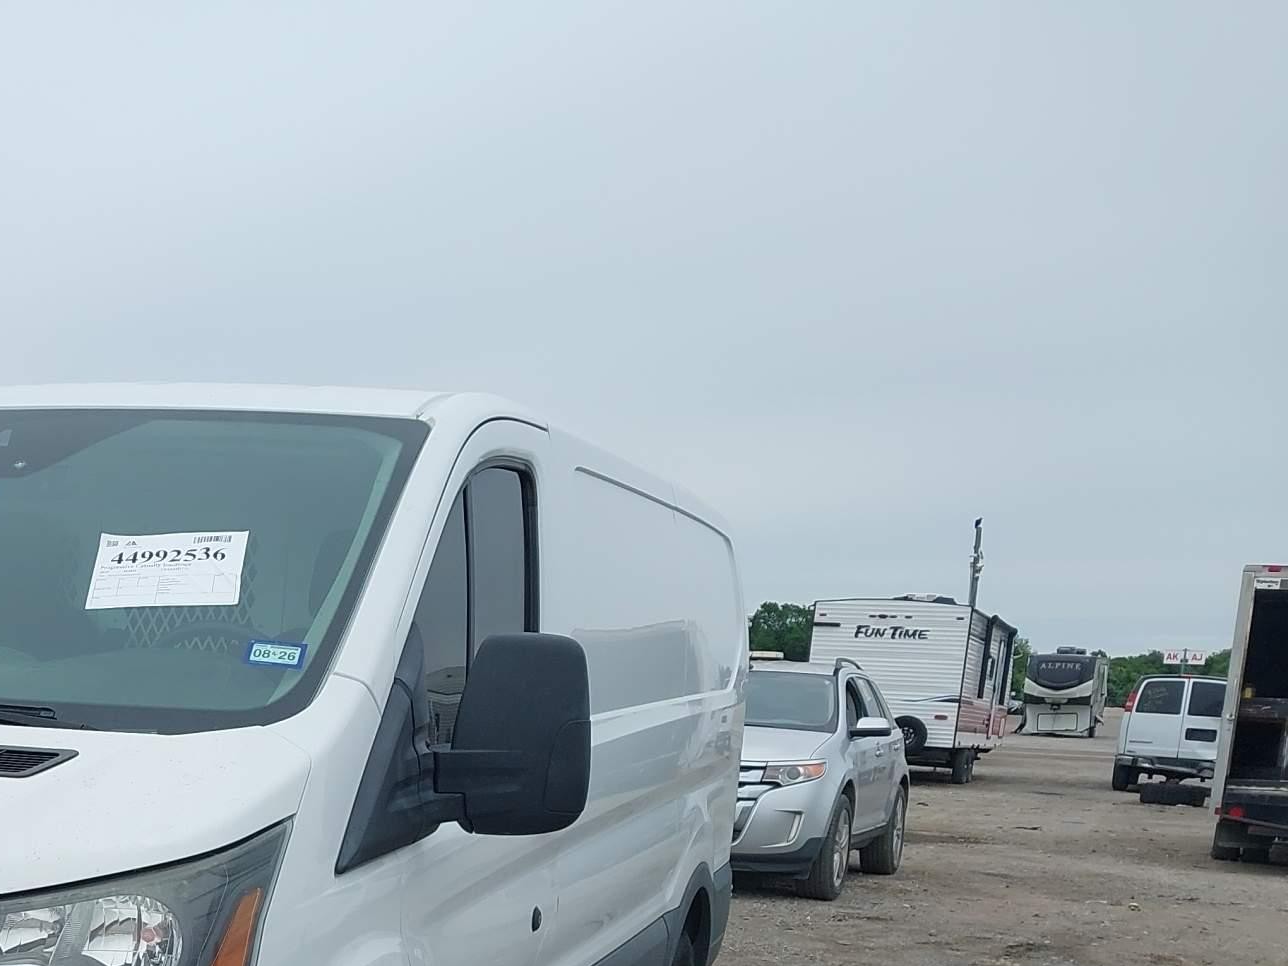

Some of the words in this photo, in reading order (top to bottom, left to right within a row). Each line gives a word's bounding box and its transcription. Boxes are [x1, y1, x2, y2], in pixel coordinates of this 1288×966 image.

[110, 546, 227, 565] 44992536
[854, 624, 888, 639] FUN
[889, 626, 931, 640] TIME
[253, 648, 271, 659] 08
[278, 650, 296, 661] 26
[1166, 652, 1178, 661] AK
[1191, 653, 1203, 661] AJ
[1039, 662, 1082, 671] ALPINE
